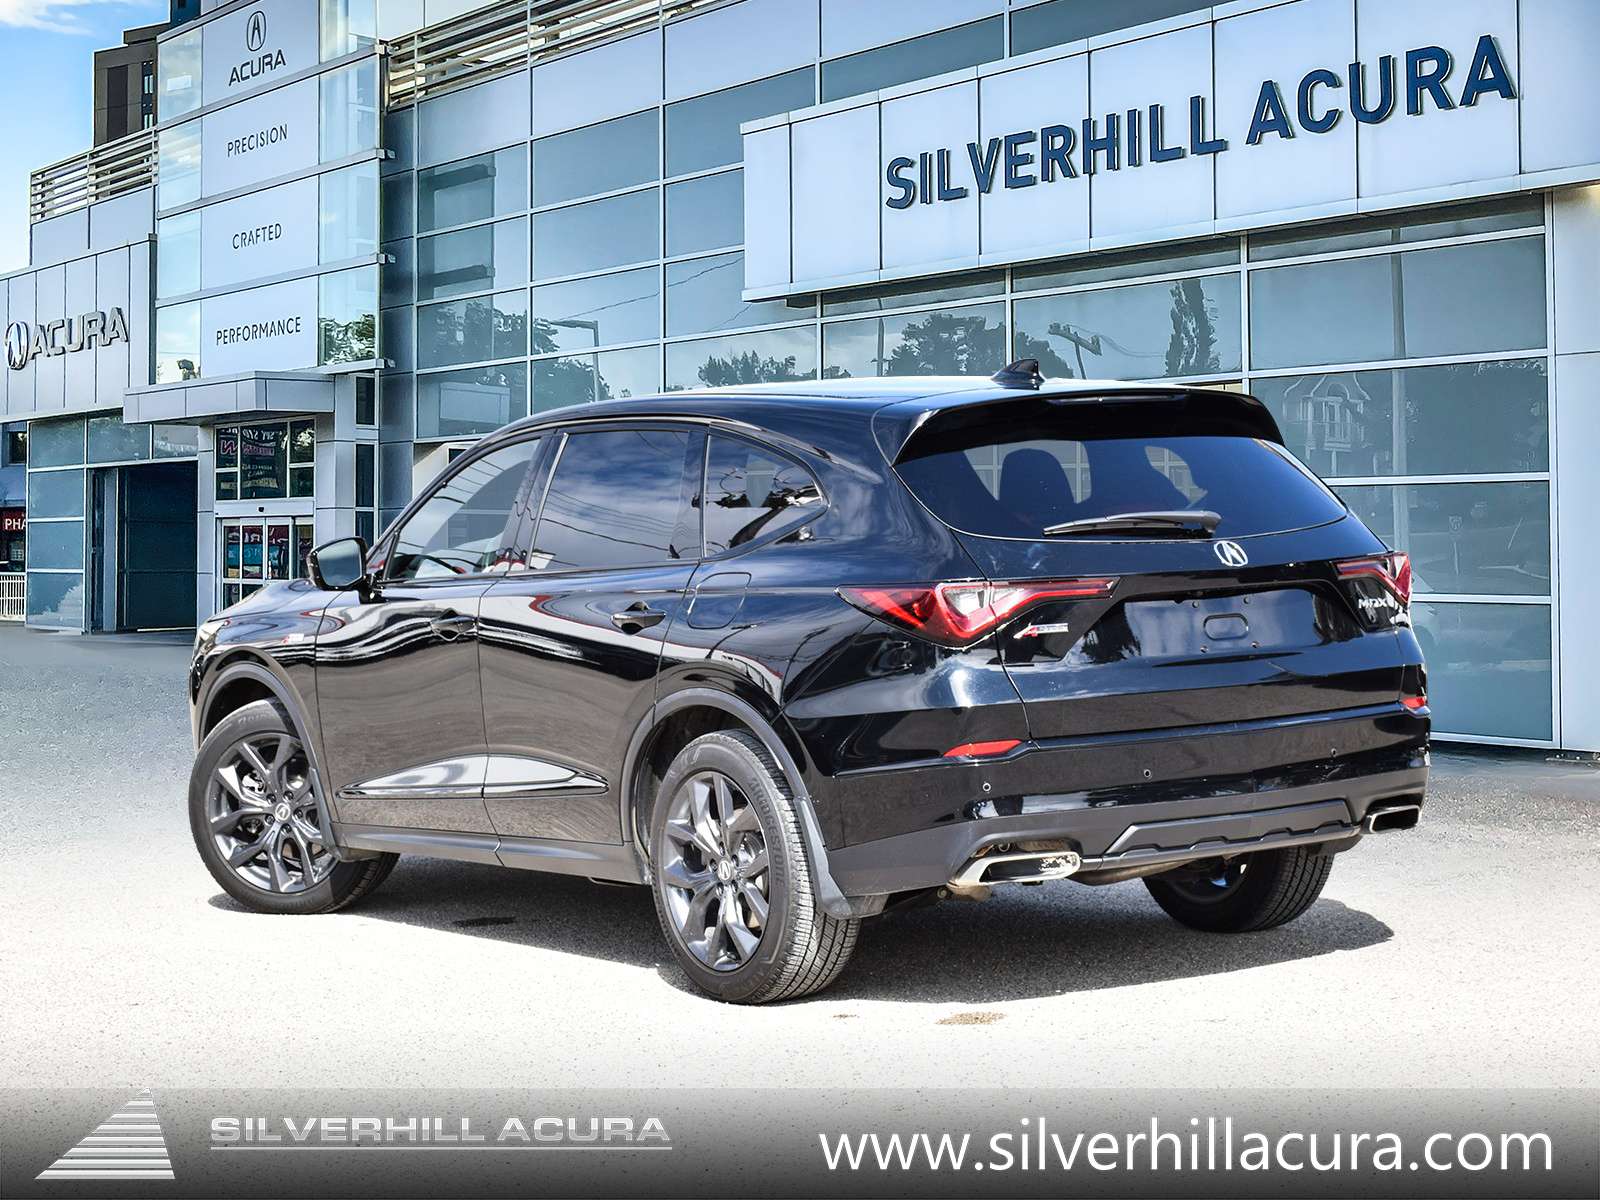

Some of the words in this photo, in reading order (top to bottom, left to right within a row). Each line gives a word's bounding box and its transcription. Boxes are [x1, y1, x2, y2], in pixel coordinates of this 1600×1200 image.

[228, 49, 287, 87] ACURA
[885, 96, 1227, 210] SILVERHILL
[1246, 34, 1519, 145] ACURA
[227, 124, 289, 157] PRECISION
[232, 223, 283, 250] CRAFTED
[28, 306, 130, 361] ACURA
[216, 316, 302, 346] PERFORMANCE
